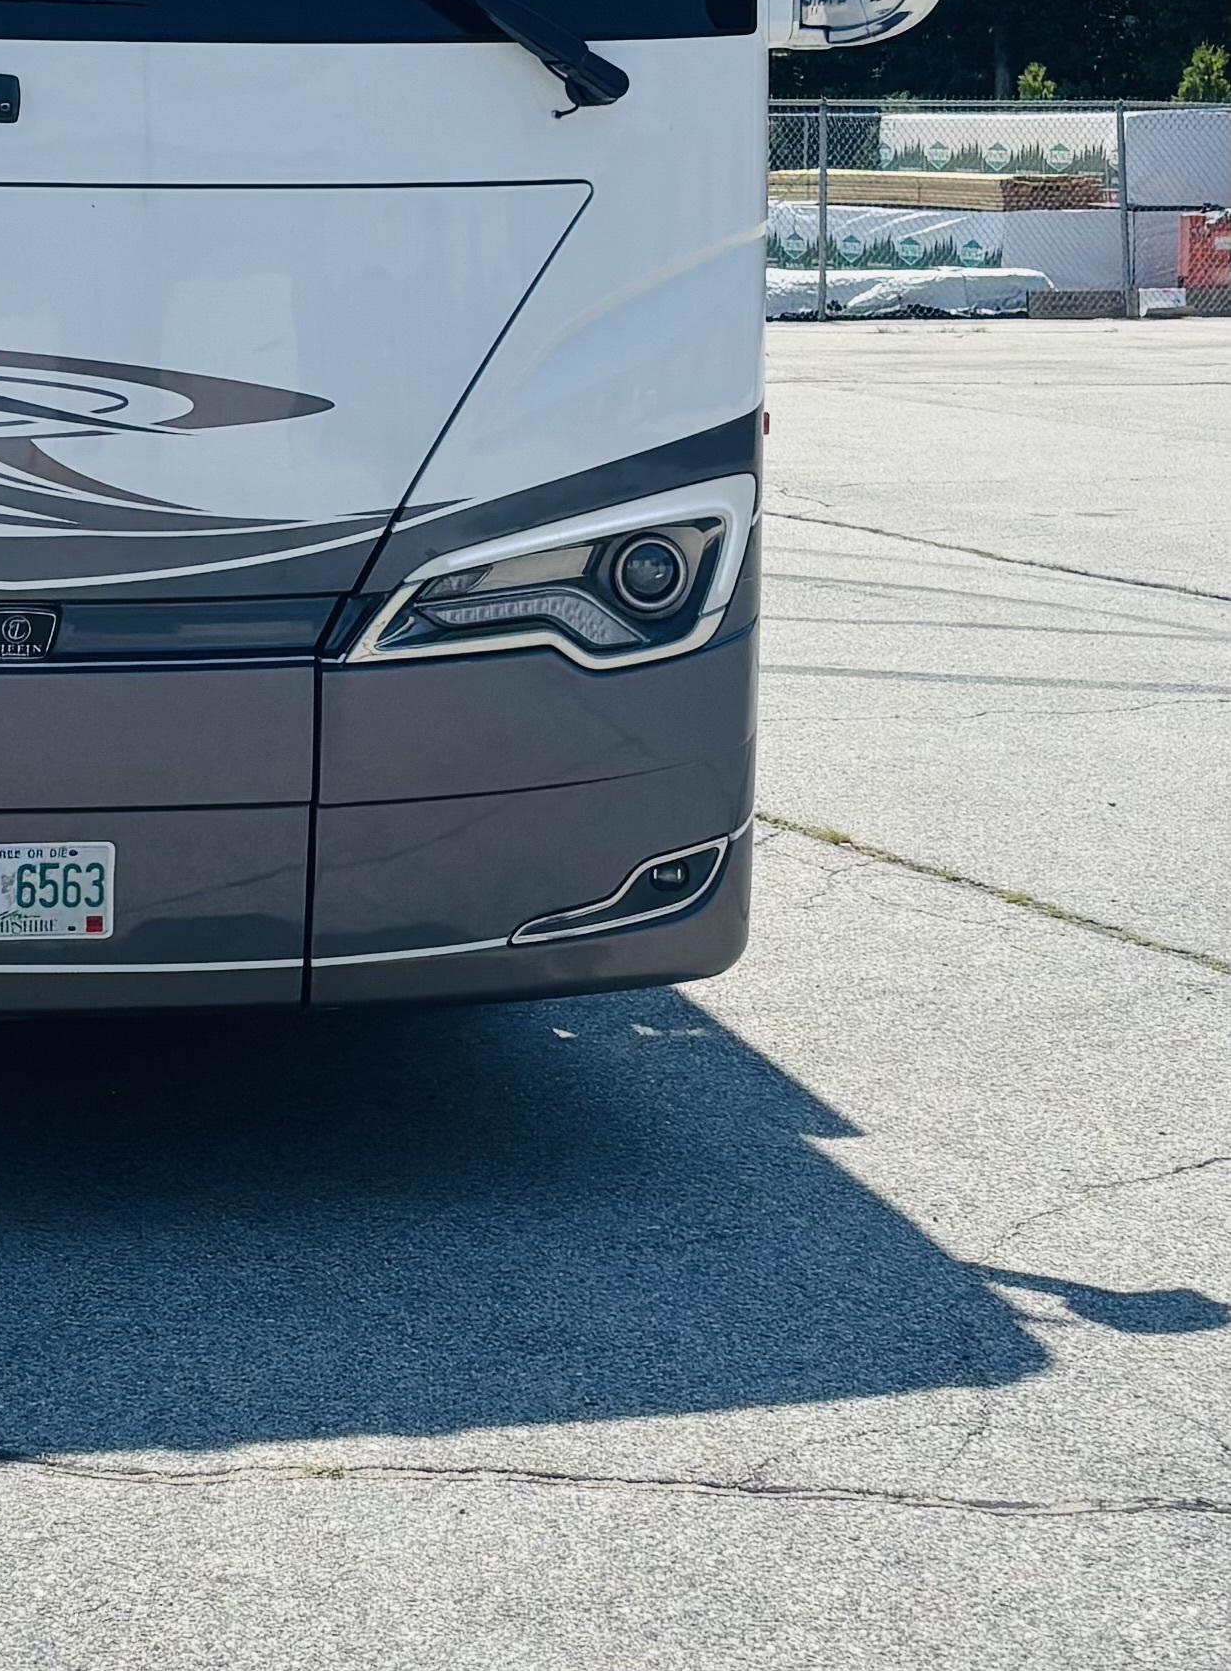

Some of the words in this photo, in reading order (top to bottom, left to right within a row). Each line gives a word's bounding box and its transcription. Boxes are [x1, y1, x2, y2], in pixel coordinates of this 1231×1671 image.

[27, 848, 44, 859] OR
[49, 846, 68, 858] DIE
[16, 862, 105, 909] 6563
